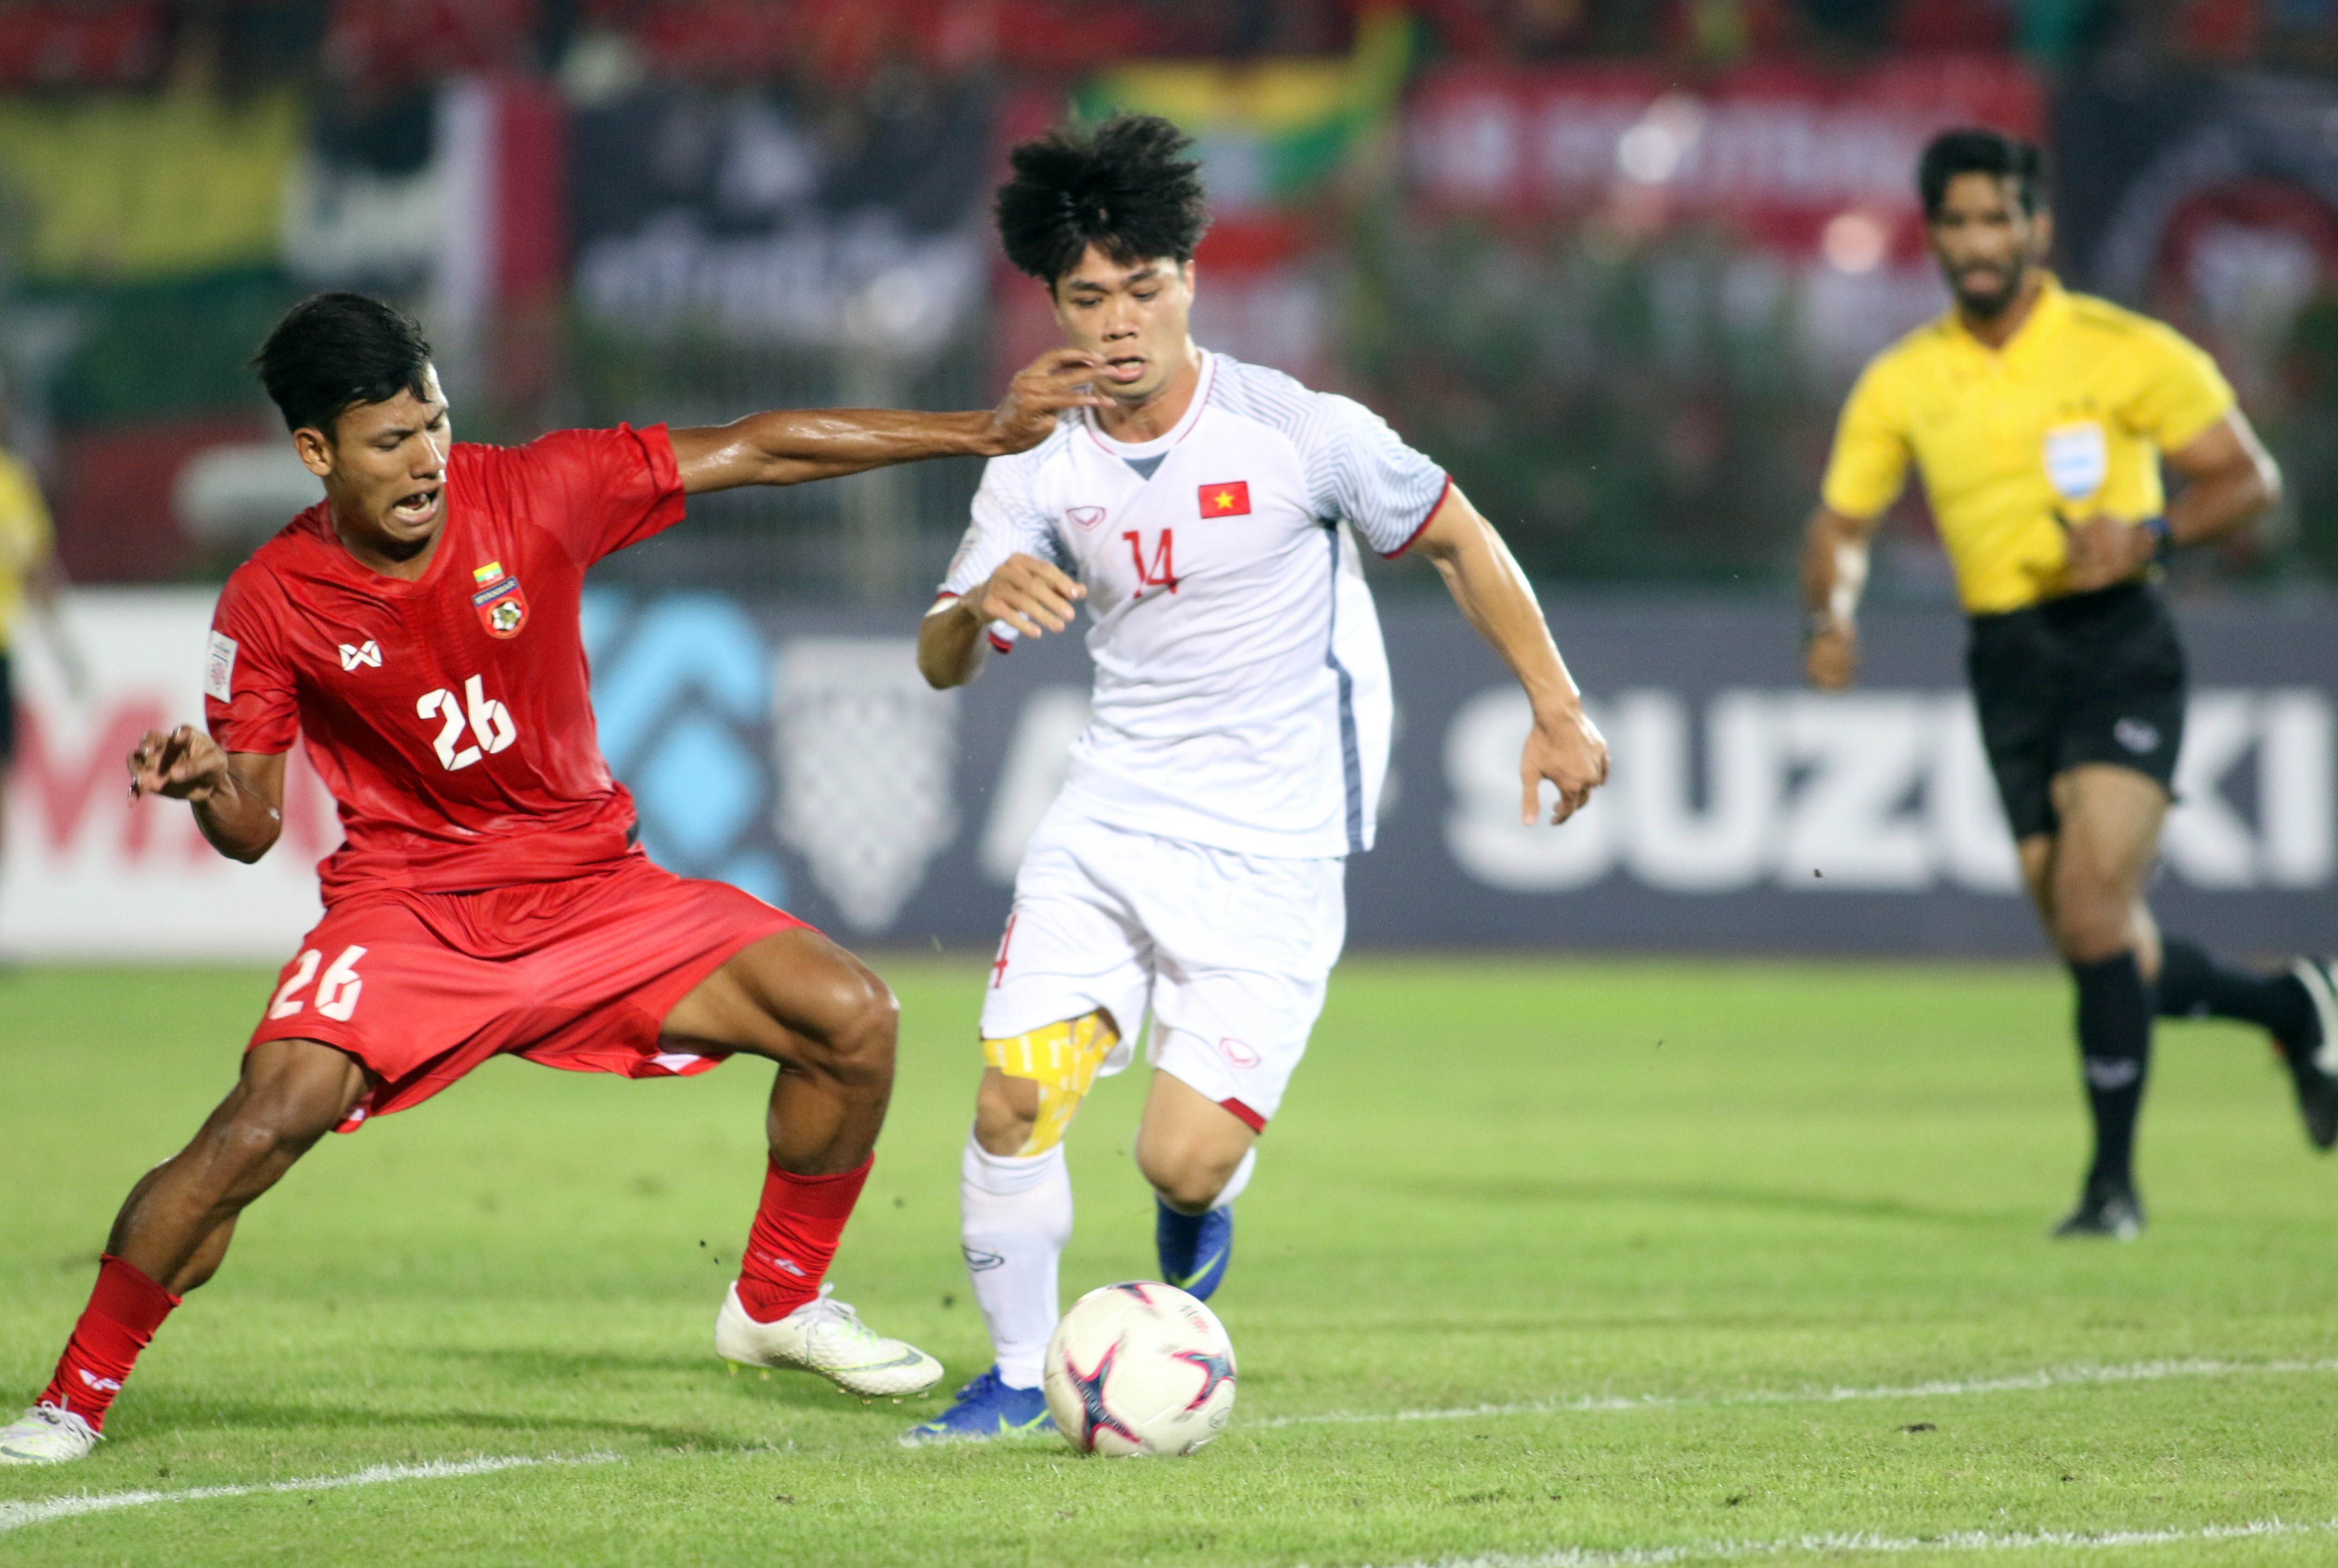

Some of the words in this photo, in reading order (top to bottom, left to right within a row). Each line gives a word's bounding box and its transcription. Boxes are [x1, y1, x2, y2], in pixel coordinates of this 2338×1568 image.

[1123, 528, 1178, 599] 14
[416, 673, 517, 771] 26
[268, 944, 368, 1023] 26
